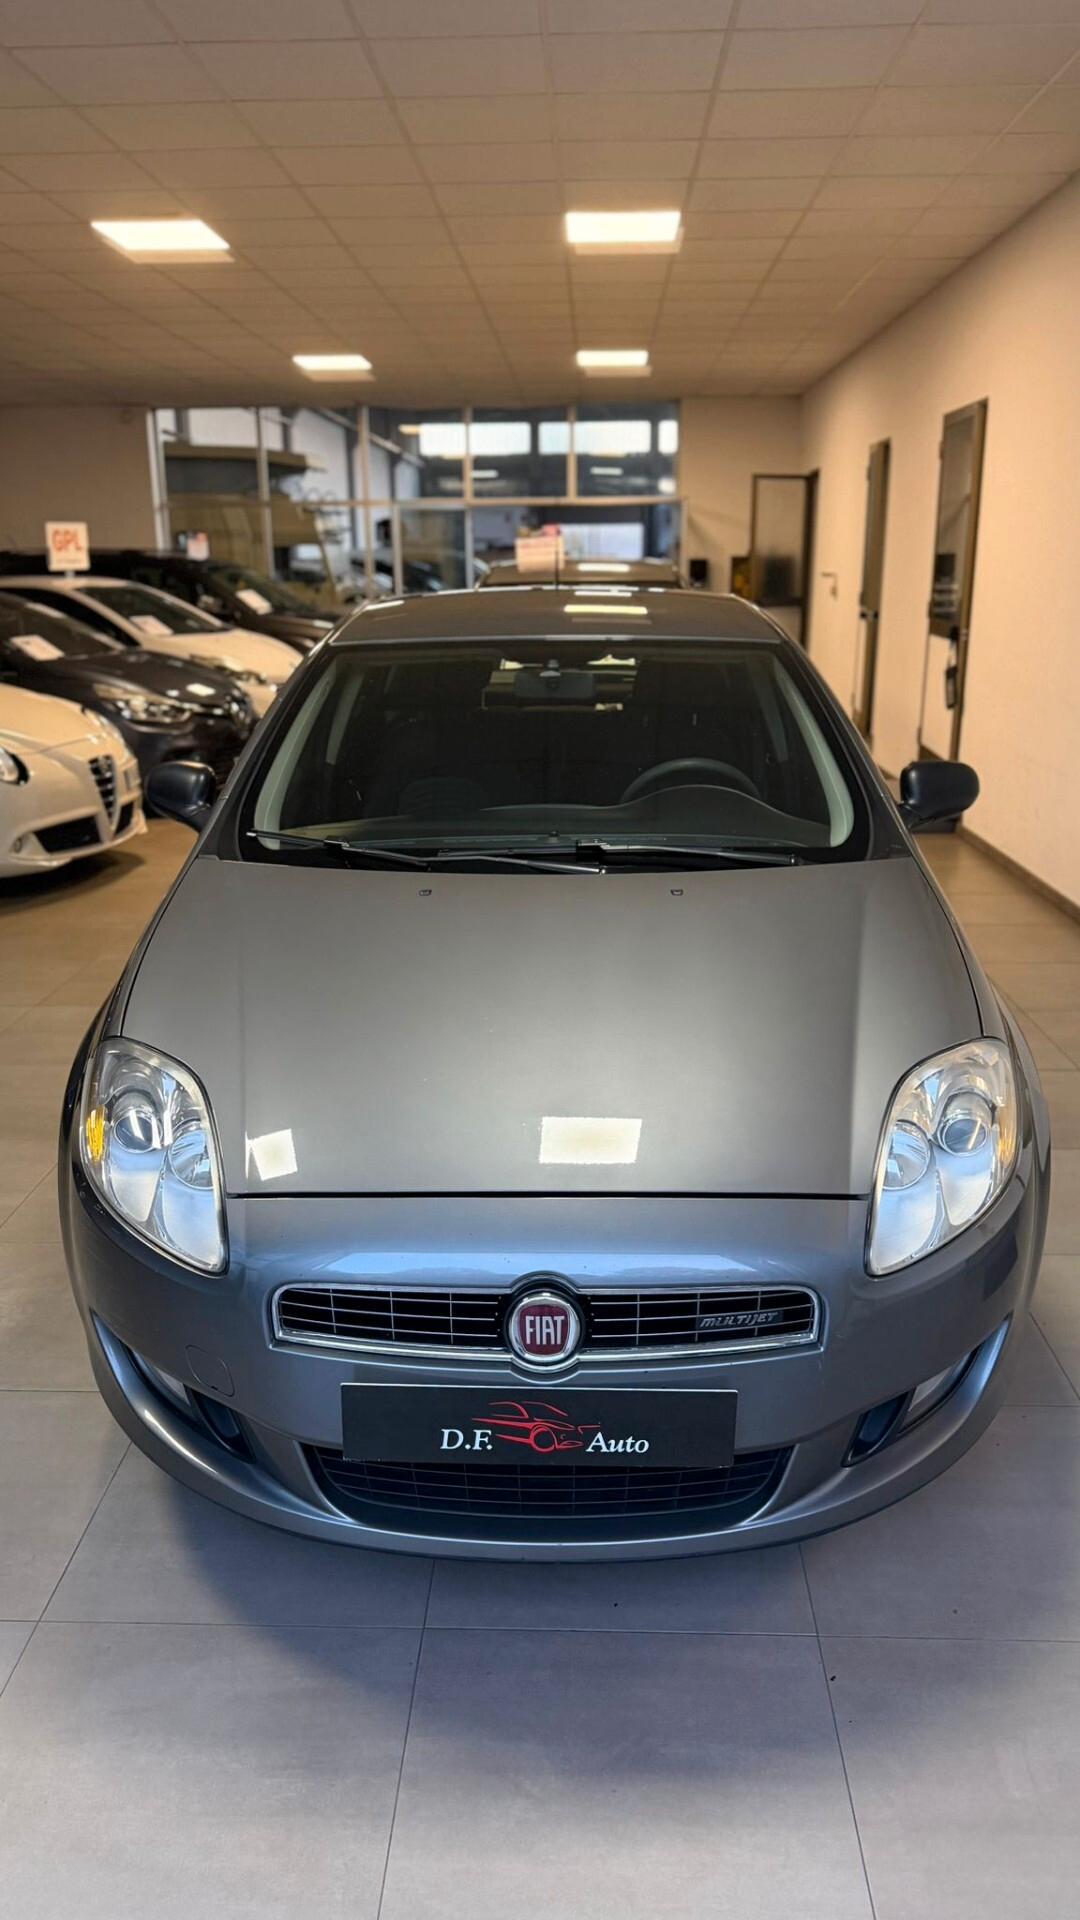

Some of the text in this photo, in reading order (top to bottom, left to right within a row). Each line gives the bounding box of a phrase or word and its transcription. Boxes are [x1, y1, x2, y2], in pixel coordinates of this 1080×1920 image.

[52, 529, 83, 551] GPL
[525, 1315, 565, 1345] FIAT
[440, 1428, 650, 1454] D.F. Auto
